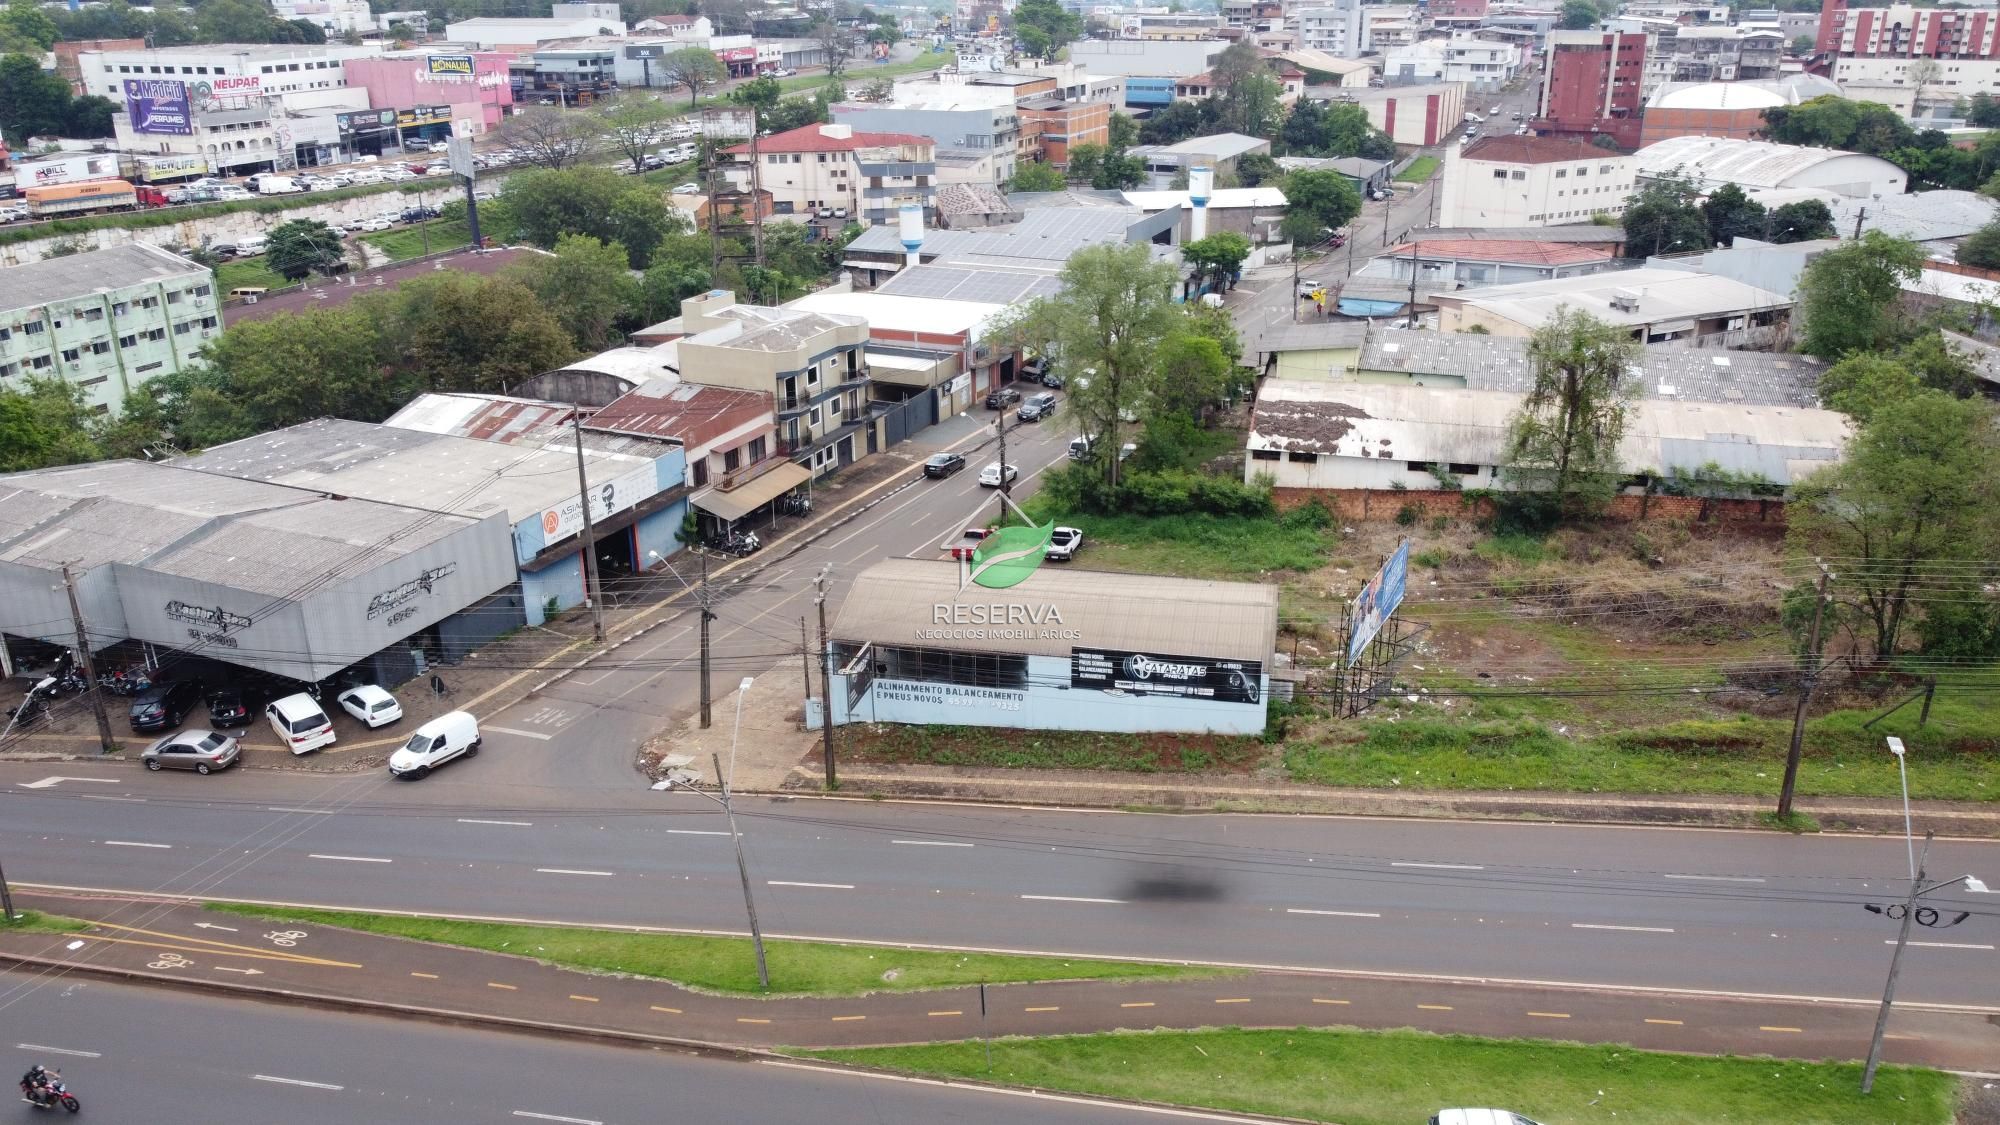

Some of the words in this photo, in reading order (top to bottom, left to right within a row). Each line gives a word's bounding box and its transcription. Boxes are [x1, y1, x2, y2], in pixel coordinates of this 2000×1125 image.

[214, 77, 260, 89] NEUPAR
[151, 115, 184, 123] PERFUMES
[154, 161, 174, 171] NEW
[176, 159, 195, 170] LIFE
[1145, 663, 1207, 677] CATARATAS
[877, 682, 943, 696] ALINHAMENTO
[945, 689, 1024, 702] BALANCEAMENTO
[884, 694, 912, 702] PNEUS
[914, 695, 943, 704] NOVOS
